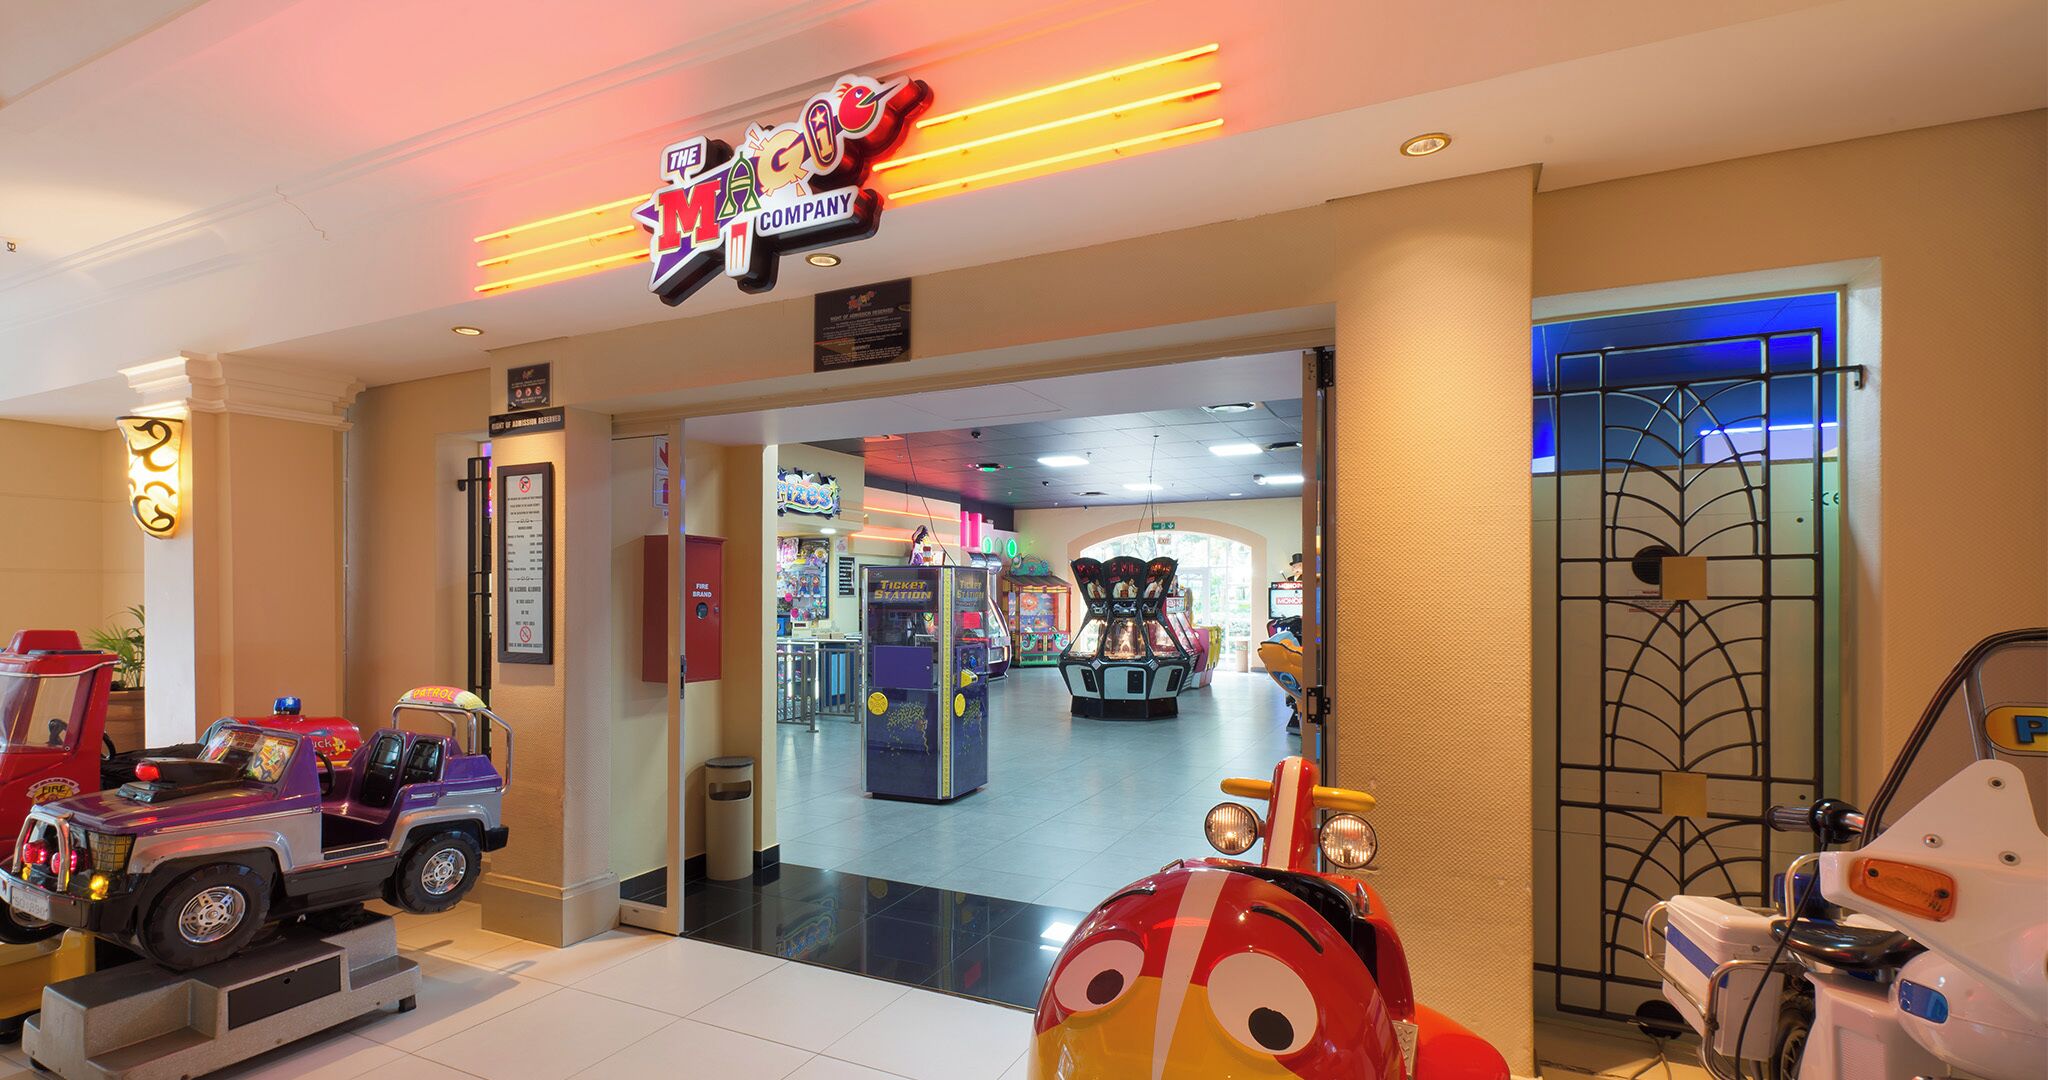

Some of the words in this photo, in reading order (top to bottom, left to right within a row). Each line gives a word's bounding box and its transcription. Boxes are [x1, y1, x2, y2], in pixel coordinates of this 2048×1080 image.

[669, 147, 698, 170] THE
[759, 192, 852, 231] COMPANY
[491, 422, 504, 430] RIGHT
[512, 418, 537, 428] ADMISSION
[538, 415, 561, 425] RESERVED
[413, 687, 453, 701] PATROL
[42, 785, 66, 794] FIRE
